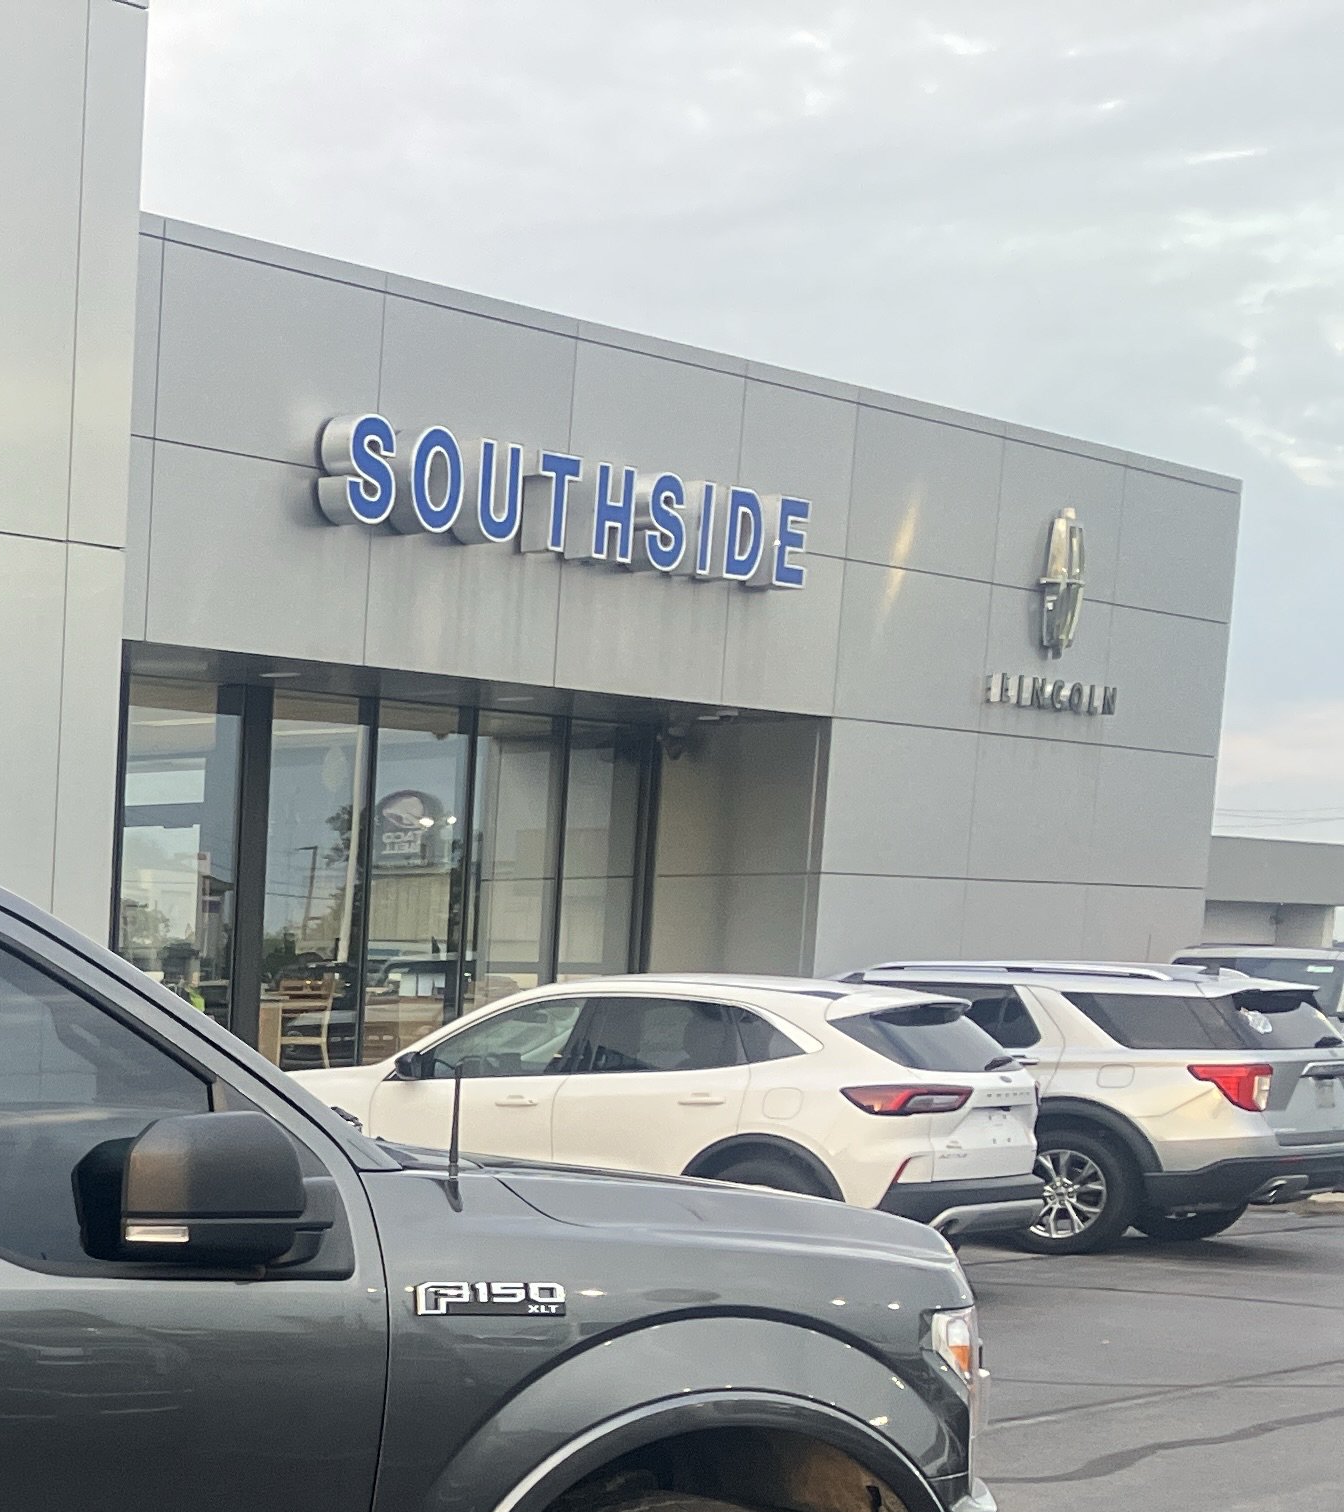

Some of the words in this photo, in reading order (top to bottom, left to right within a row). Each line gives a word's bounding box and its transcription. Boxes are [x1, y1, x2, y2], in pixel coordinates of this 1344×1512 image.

[318, 413, 811, 590] SOUTHSIDE
[985, 672, 1118, 716] LINCOLN
[528, 1304, 560, 1314] XLT
